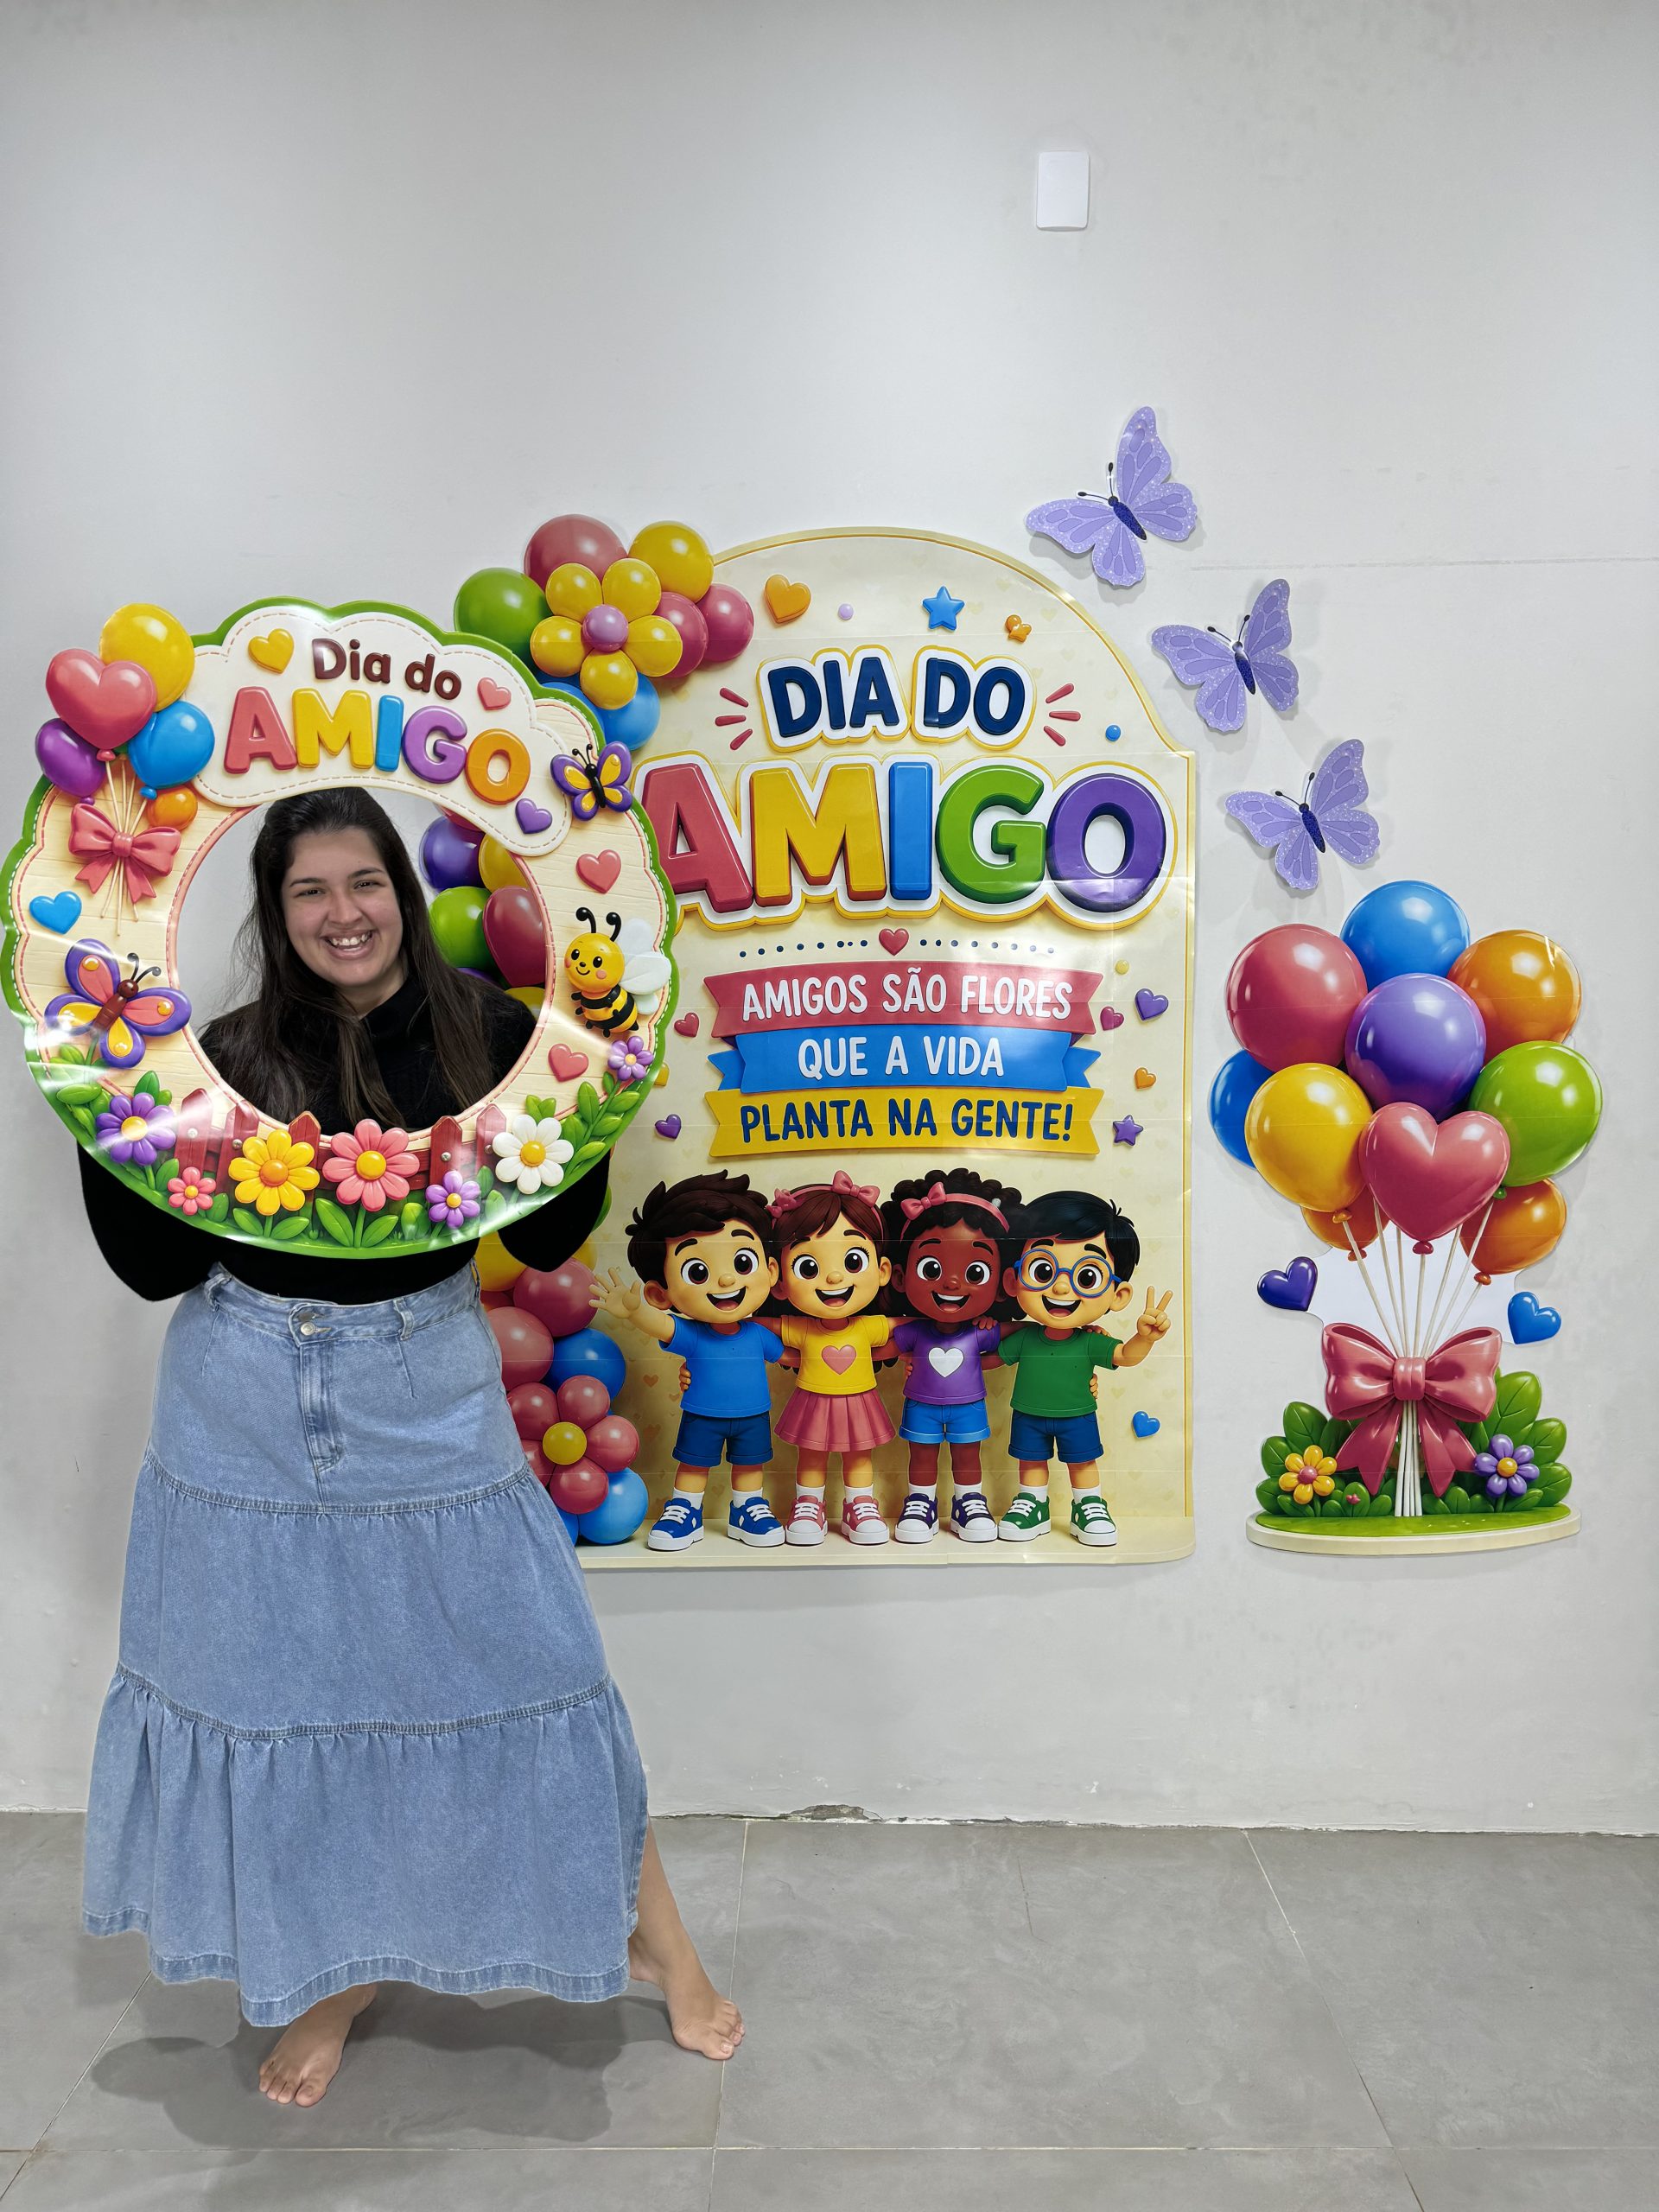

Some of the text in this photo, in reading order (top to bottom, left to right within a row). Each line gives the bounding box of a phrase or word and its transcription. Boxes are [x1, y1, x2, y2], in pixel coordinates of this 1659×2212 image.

[312, 638, 462, 701] Dia do
[766, 656, 1027, 739] DIA DO
[223, 686, 531, 805] AMIGO
[641, 761, 1166, 913] AMIGO
[742, 967, 1072, 1021] AMIGOS SÃO FLORES
[798, 1035, 1004, 1081] QUE A VIDA
[741, 1097, 1073, 1144] PLANTA NA GENTE!
